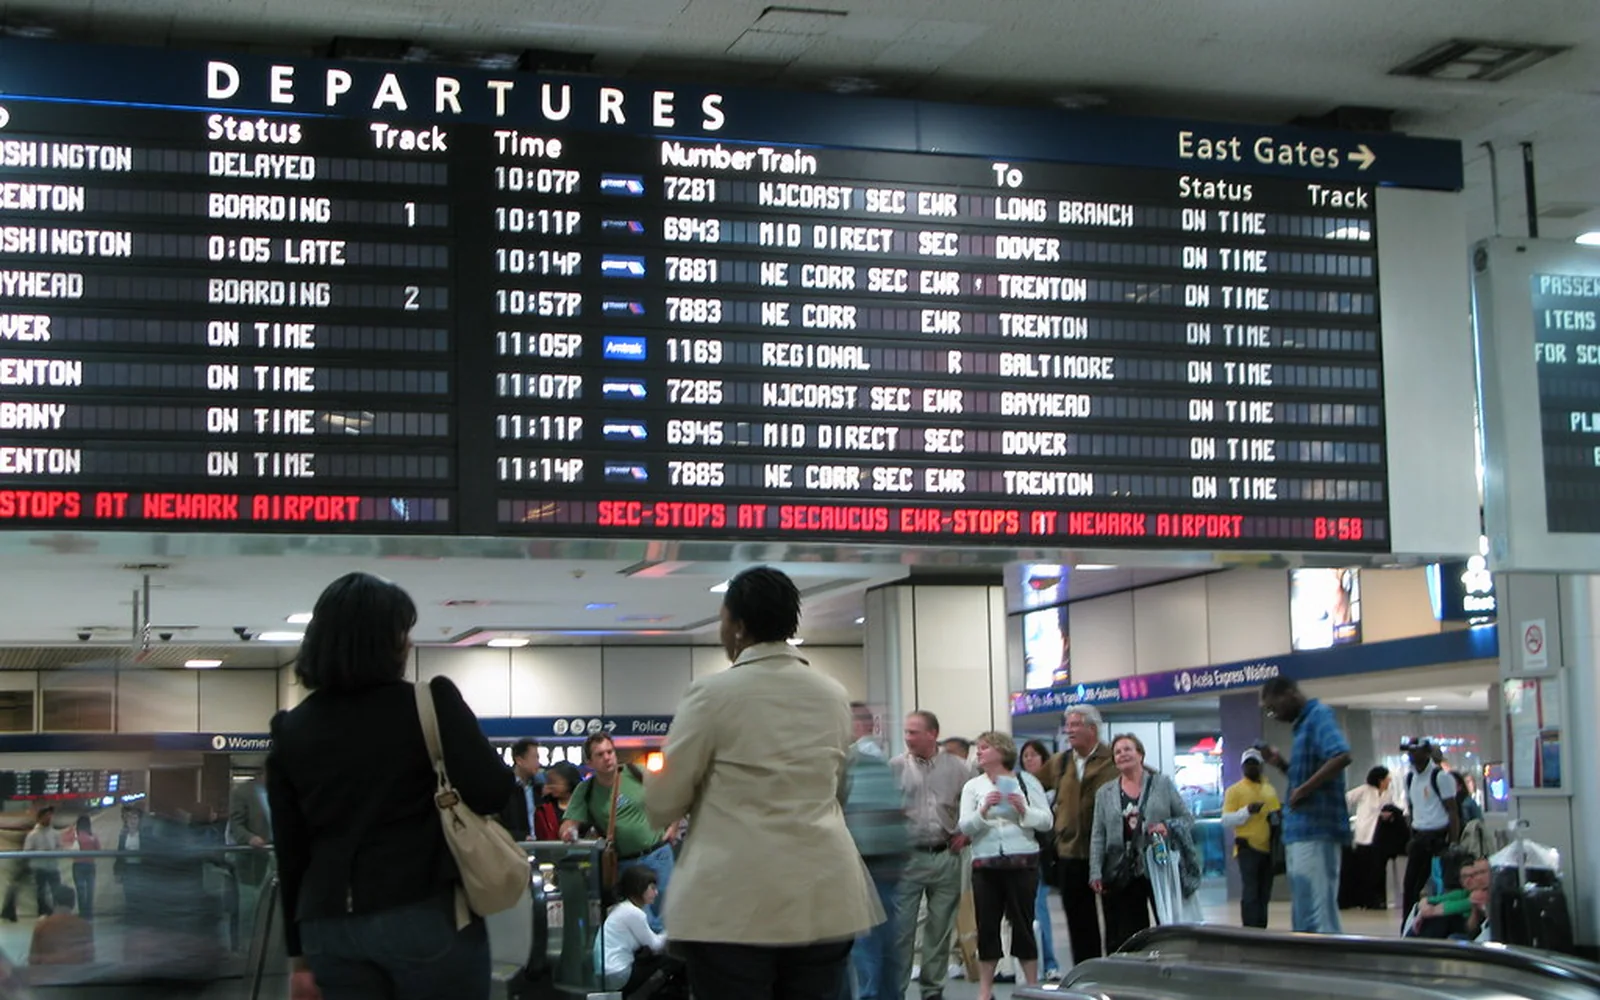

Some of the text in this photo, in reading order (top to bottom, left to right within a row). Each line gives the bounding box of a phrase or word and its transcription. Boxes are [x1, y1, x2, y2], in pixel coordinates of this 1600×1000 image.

[207, 61, 727, 131] DEPARTURES
[207, 114, 447, 152] Status Track
[493, 130, 817, 175] Time Number Train
[1179, 131, 1339, 168] East Gates
[0, 140, 315, 180] SHINGTON DELAYED
[0, 182, 415, 227] ENTON BOARDING 1
[495, 166, 1266, 235] 10:07P 7281 NJCOAST SEC EWR LONG BRANCH ON TIME
[991, 162, 1368, 208] To Status Track
[0, 226, 132, 257] SHINGTON
[285, 238, 346, 266] LATE
[496, 207, 1268, 272] 10:11P 6943 MID DIRECT SEC DOVER ON TIME
[0, 270, 419, 309] YHEAD BOARDING 2
[496, 248, 1270, 310] 10:14P 7881 NE CORR SEC EWR TRENTON ON TIME
[0, 314, 315, 349] VER ON TIME
[496, 289, 1271, 347] 10:57P 7883 NE CORR EWR TRENTON ON TIME
[1545, 310, 1596, 330] ITEMS
[497, 331, 583, 358] 11:05P
[666, 338, 723, 364] 1169
[762, 342, 871, 371] REGIONAL
[947, 350, 963, 375] R
[999, 352, 1115, 380] BALTIMORE
[1187, 360, 1213, 384] ON
[1224, 362, 1273, 386] TIME
[1535, 342, 1566, 363] FOR
[207, 364, 239, 390] ON
[253, 365, 315, 392] TIME
[497, 373, 1274, 424] 11:07P 7285 NJCOAST SEC EWR BAYHEAD ON TIME
[207, 407, 239, 433] ON
[253, 408, 315, 434] TIME
[497, 414, 1276, 462] 11:11P 6945 MID DIRECT SEC DOVER ON TIME
[1570, 411, 1600, 432] PL
[207, 451, 238, 476] ON
[254, 452, 315, 477] TIME
[498, 457, 1278, 500] 11:14P 7885 NE CORR SEC EWR TRENTON ON TIME
[95, 491, 129, 518] AT
[143, 493, 239, 520] NEWARK
[252, 494, 361, 521] AIRPORT
[597, 500, 1363, 540] SEC-STOPS AT SECAUCUS EWR-STOPS AT NEWARK AIRPORT 8:58
[632, 720, 667, 732] Police
